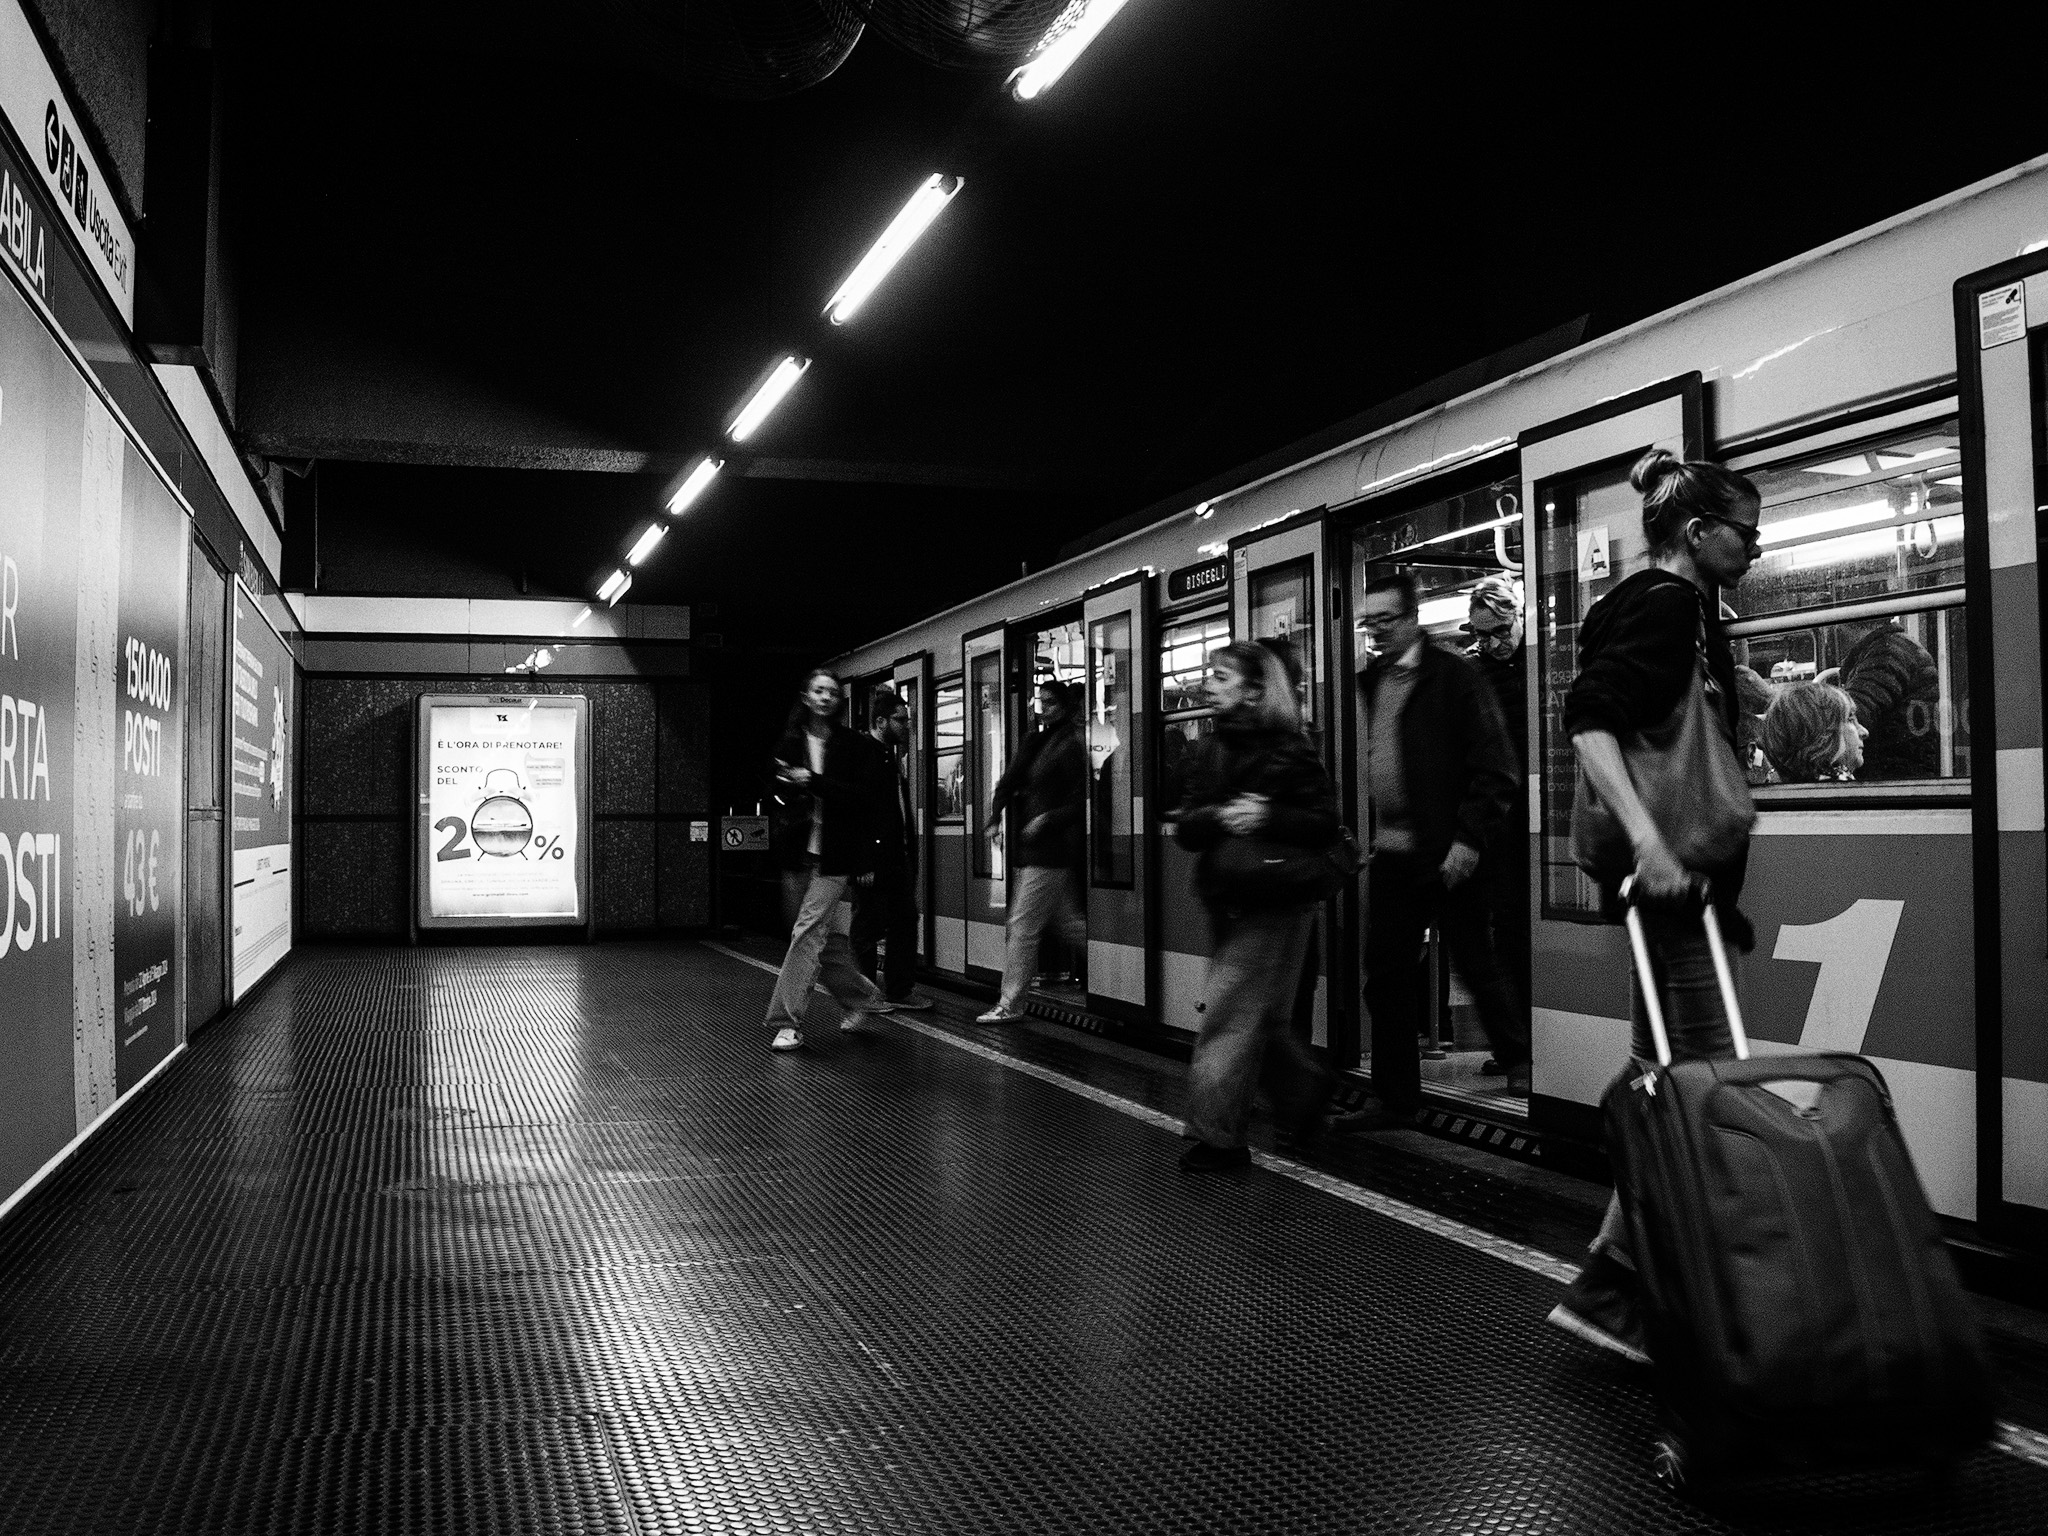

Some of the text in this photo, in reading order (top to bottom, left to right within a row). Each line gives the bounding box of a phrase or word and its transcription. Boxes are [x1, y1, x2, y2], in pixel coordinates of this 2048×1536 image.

[89, 188, 127, 295] Uscita Exit
[1186, 564, 1226, 590] BISCEGLI
[124, 635, 171, 712] 150.000
[124, 709, 161, 777] POSTI
[437, 765, 484, 774] SCONTO
[447, 741, 480, 749] L'ORA
[496, 742, 563, 750] PRENOTARE!
[437, 777, 458, 786] DEL
[123, 828, 160, 917] 43 €
[1772, 898, 1905, 1056] 1
